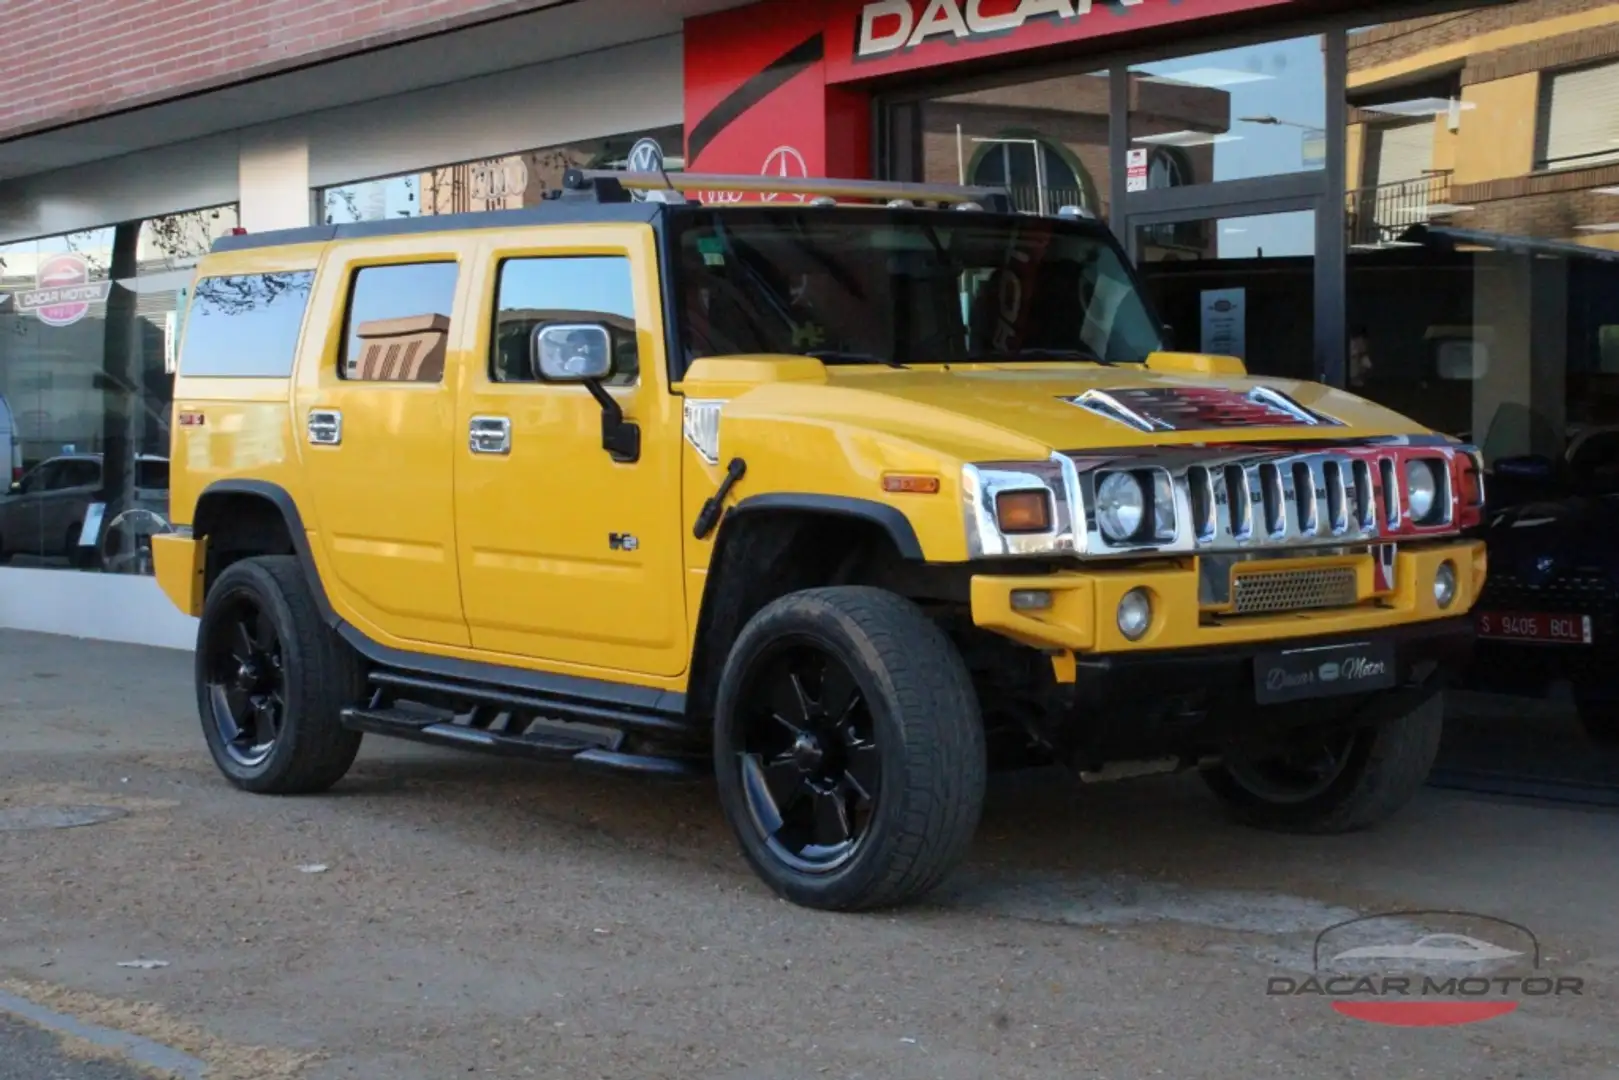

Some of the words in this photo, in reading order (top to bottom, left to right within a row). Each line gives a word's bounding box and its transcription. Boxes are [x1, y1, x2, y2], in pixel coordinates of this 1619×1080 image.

[858, 0, 1144, 56] DAC
[1481, 616, 1491, 633] S
[1501, 616, 1538, 636] 9405
[1550, 618, 1578, 638] BCL
[1341, 656, 1386, 680] Motor
